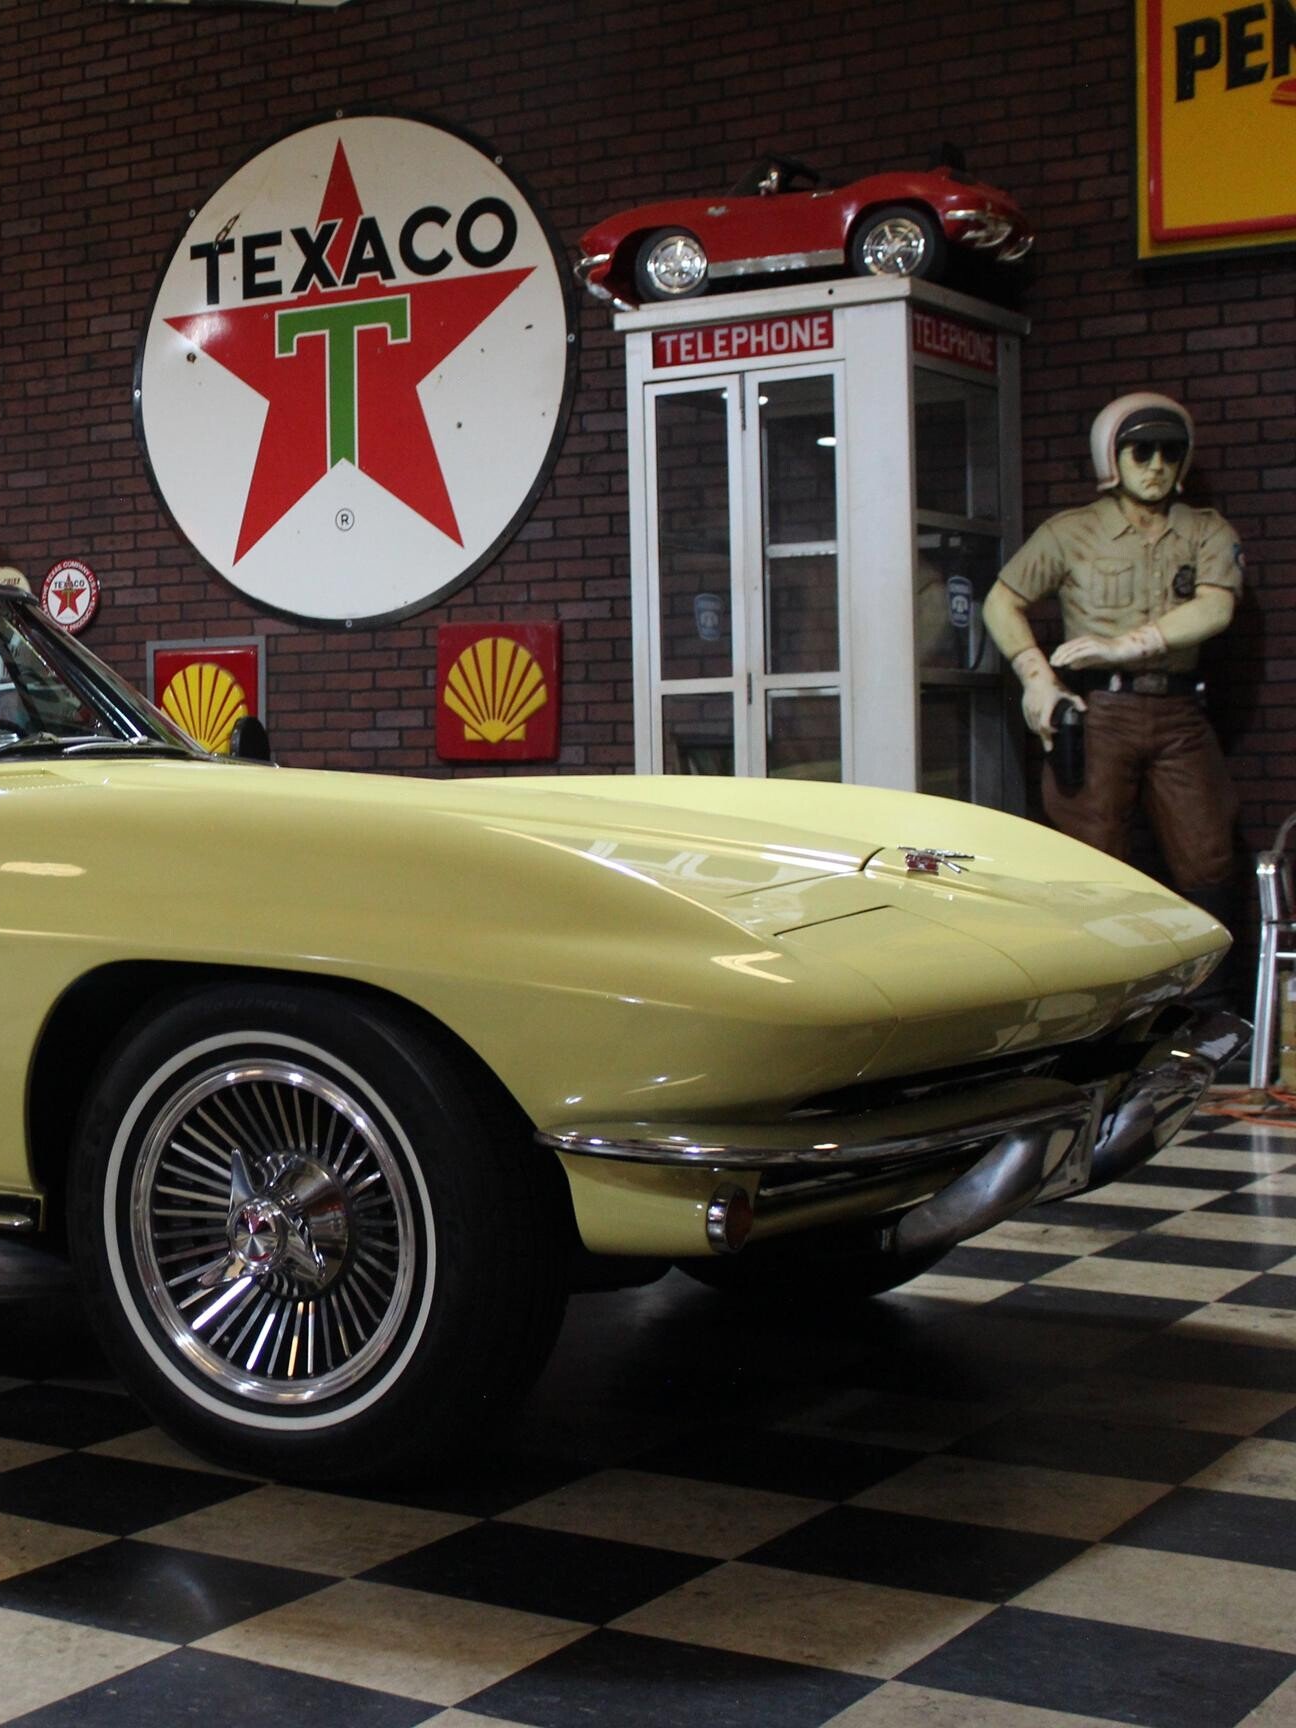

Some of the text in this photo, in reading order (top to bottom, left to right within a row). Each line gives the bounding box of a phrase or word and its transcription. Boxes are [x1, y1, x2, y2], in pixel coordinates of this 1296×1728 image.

[190, 196, 518, 306] TEXACO
[658, 316, 829, 364] TELEPHONE
[914, 314, 994, 367] TELEPHONE
[275, 295, 411, 471] T
[54, 580, 85, 589] TEXACO
[62, 561, 91, 576] COMPANY
